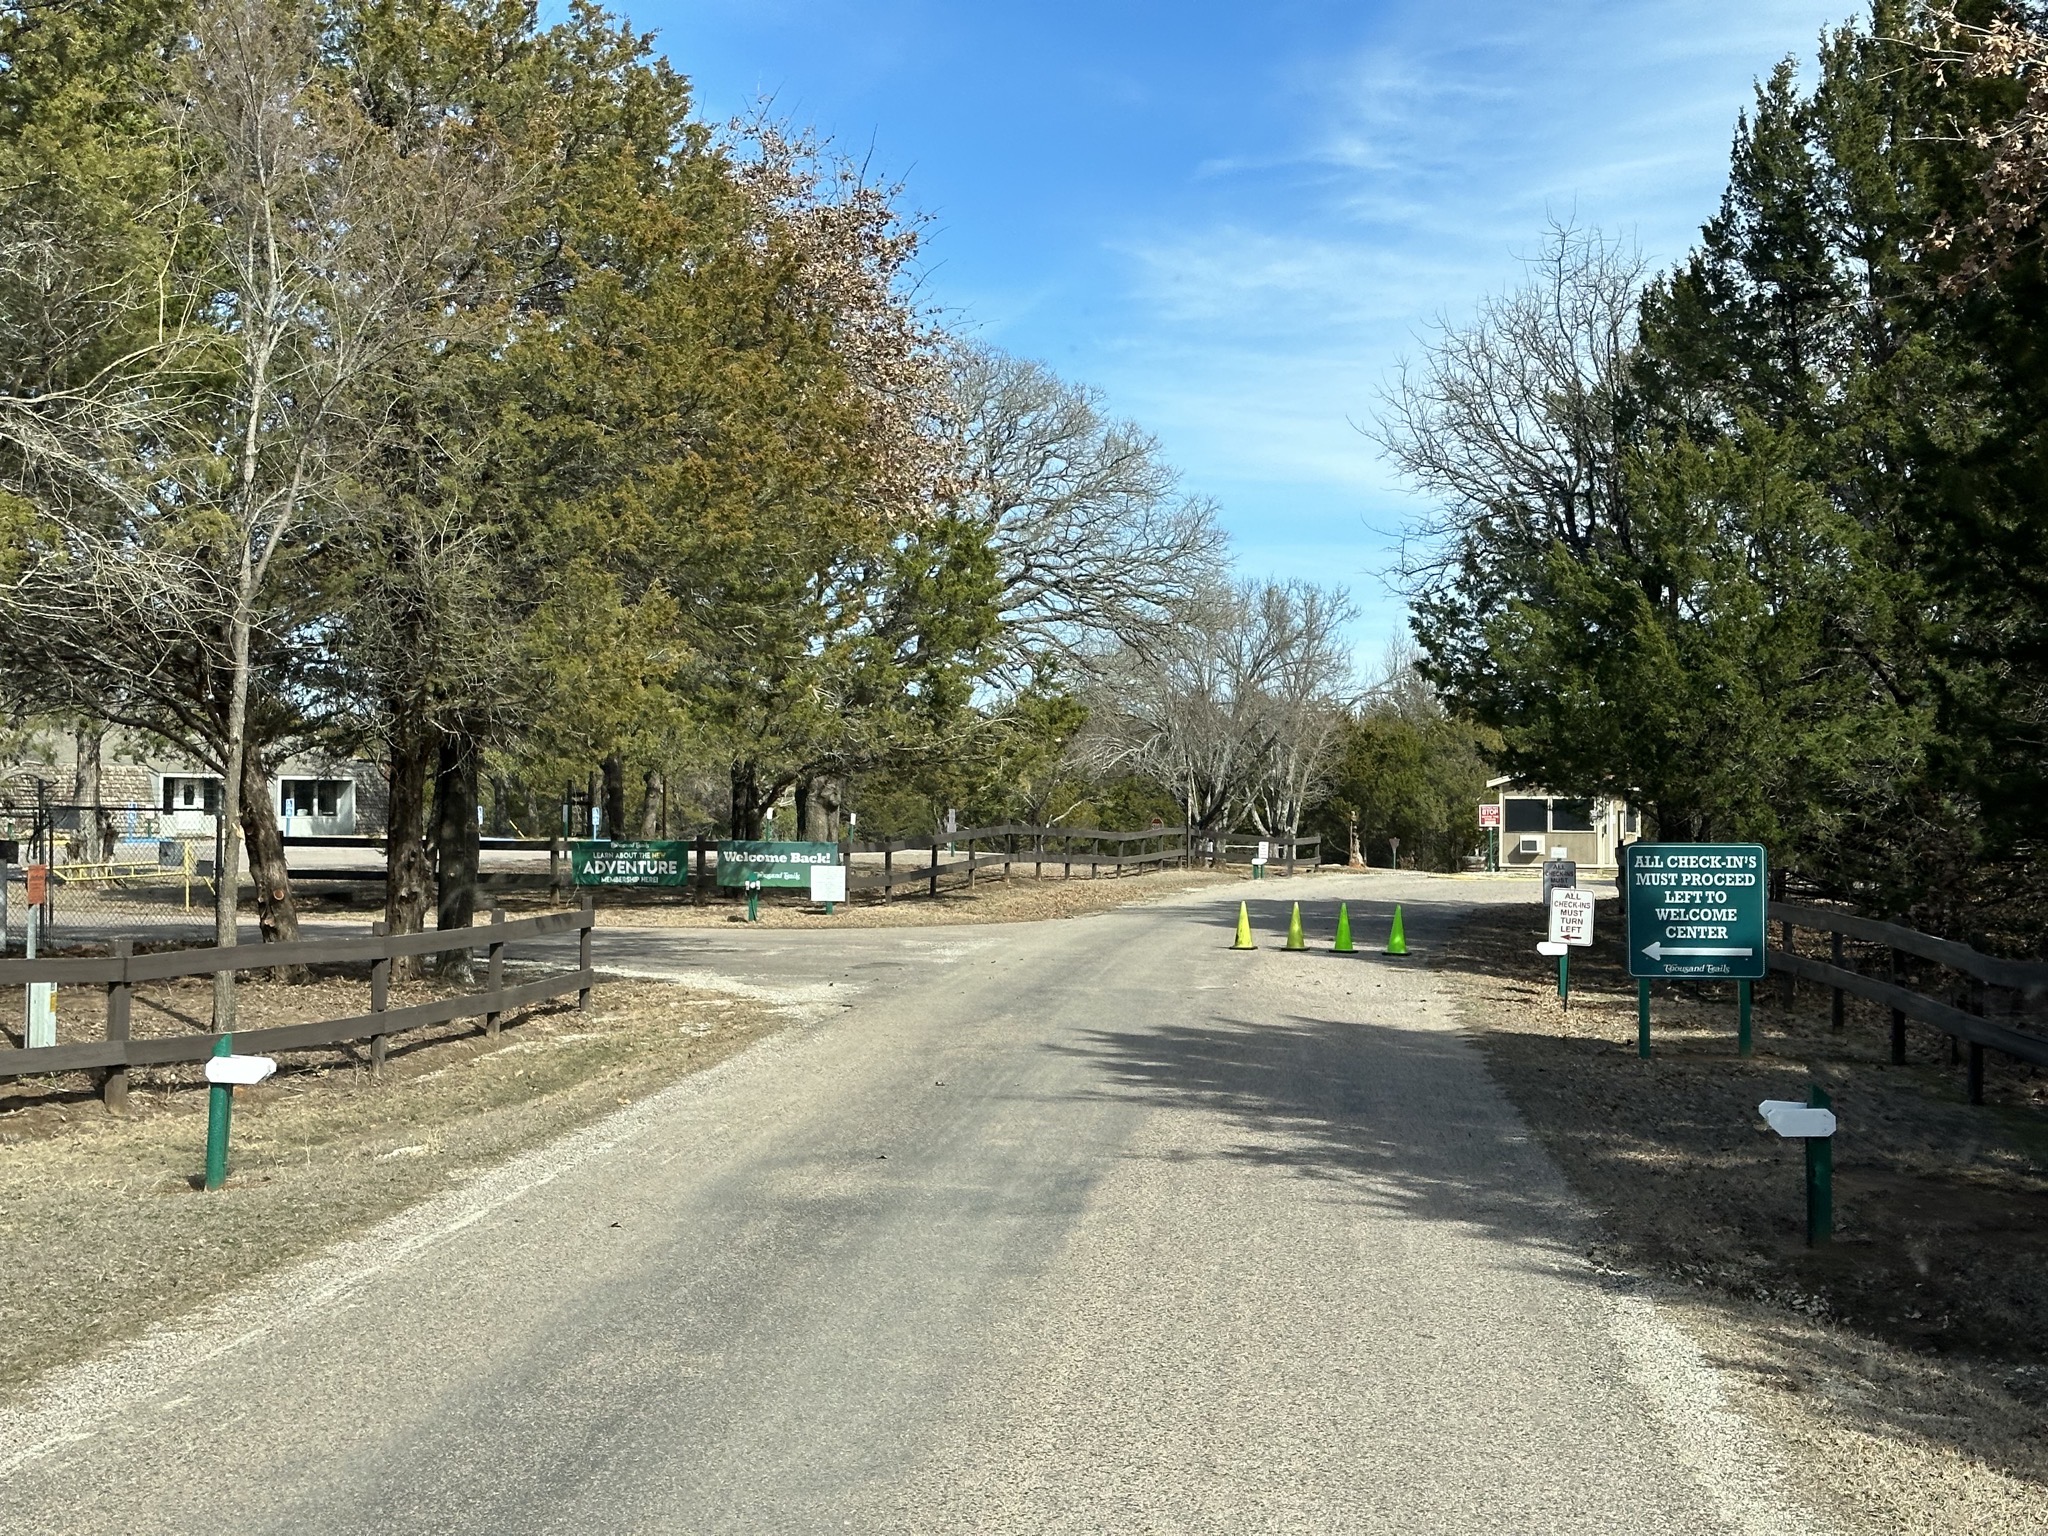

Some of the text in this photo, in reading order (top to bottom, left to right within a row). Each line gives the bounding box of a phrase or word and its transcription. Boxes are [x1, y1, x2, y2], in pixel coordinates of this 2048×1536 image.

[723, 851, 831, 864] Welcome Back!
[1634, 855, 1757, 869] ALL CHECK-IN'S
[583, 860, 678, 875] ADVENTURE
[1635, 873, 1756, 886] MUST PROCEED
[1664, 891, 1727, 903] LEFT TO
[1554, 901, 1591, 909] CHECK-INS
[1560, 909, 1583, 917] MUST
[1655, 908, 1737, 921] WELCOME
[1560, 917, 1583, 925] TURN
[1665, 926, 1728, 939] CENTER
[1664, 964, 1730, 974] Thousand Trails
